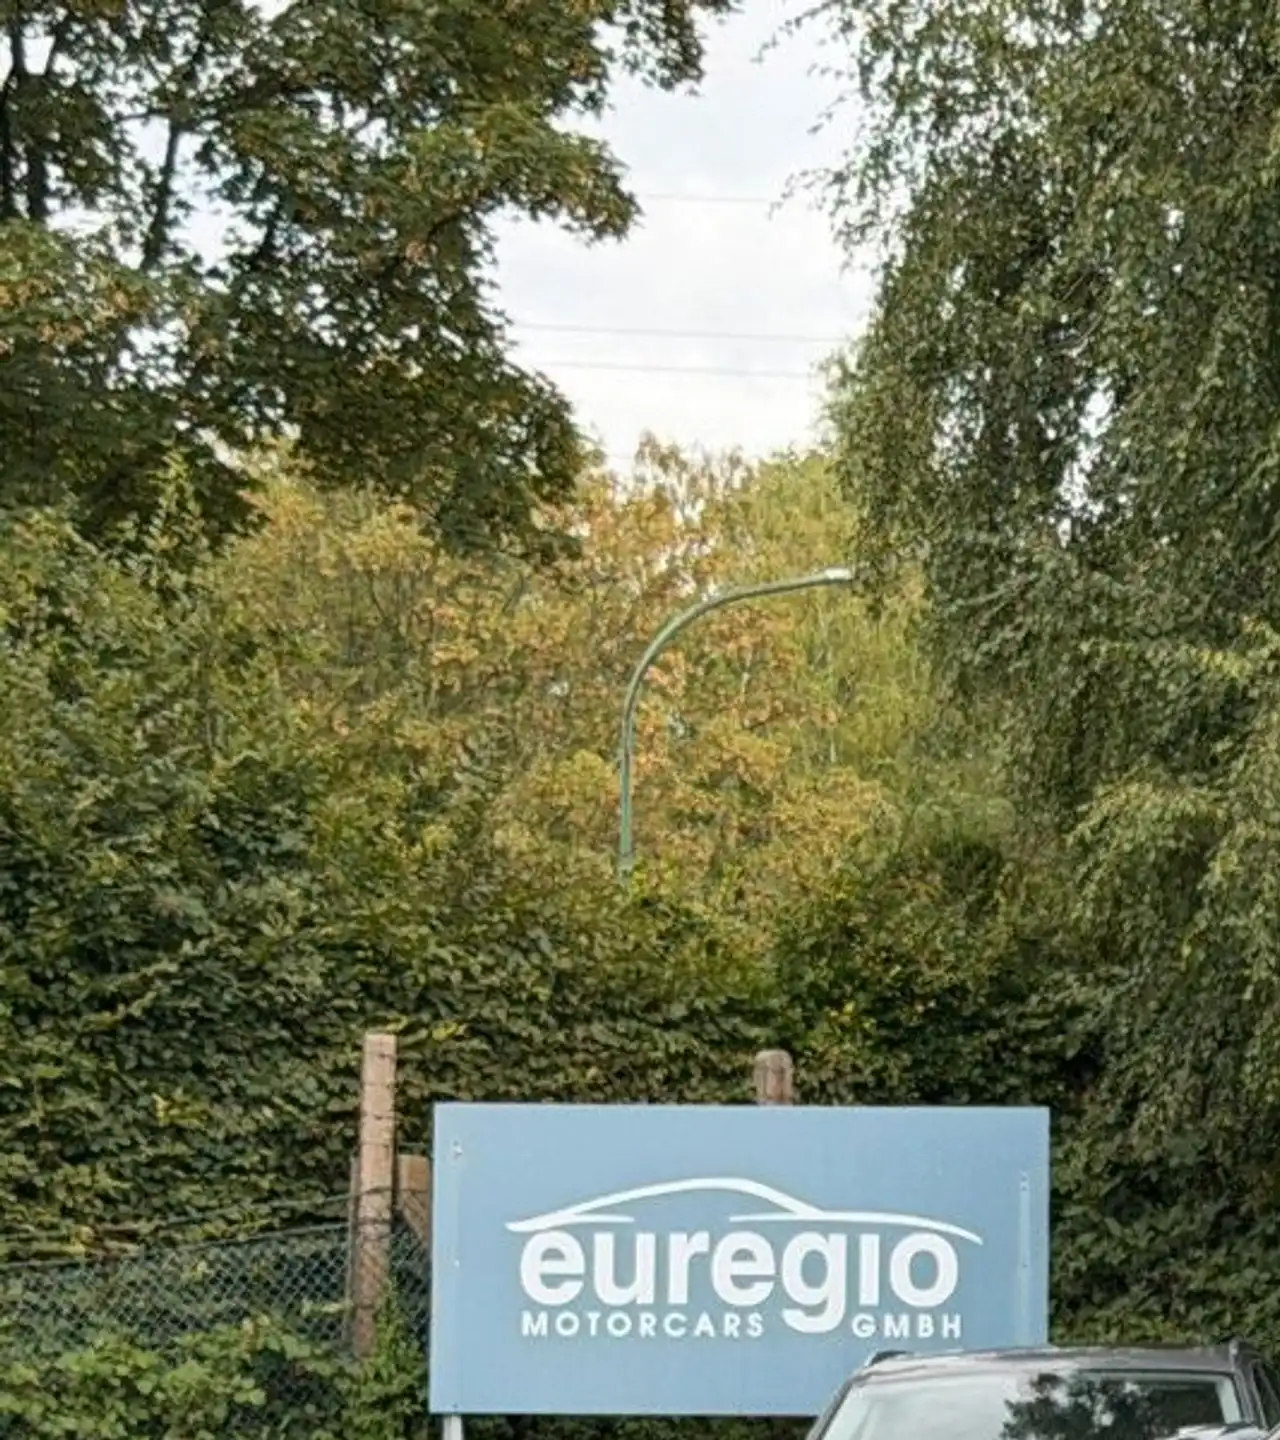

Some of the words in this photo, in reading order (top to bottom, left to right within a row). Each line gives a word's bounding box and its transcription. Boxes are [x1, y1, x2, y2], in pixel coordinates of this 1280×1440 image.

[520, 1231, 959, 1333] euregio
[521, 1311, 764, 1338] MOTORCARS
[852, 1316, 962, 1339] GMBH
